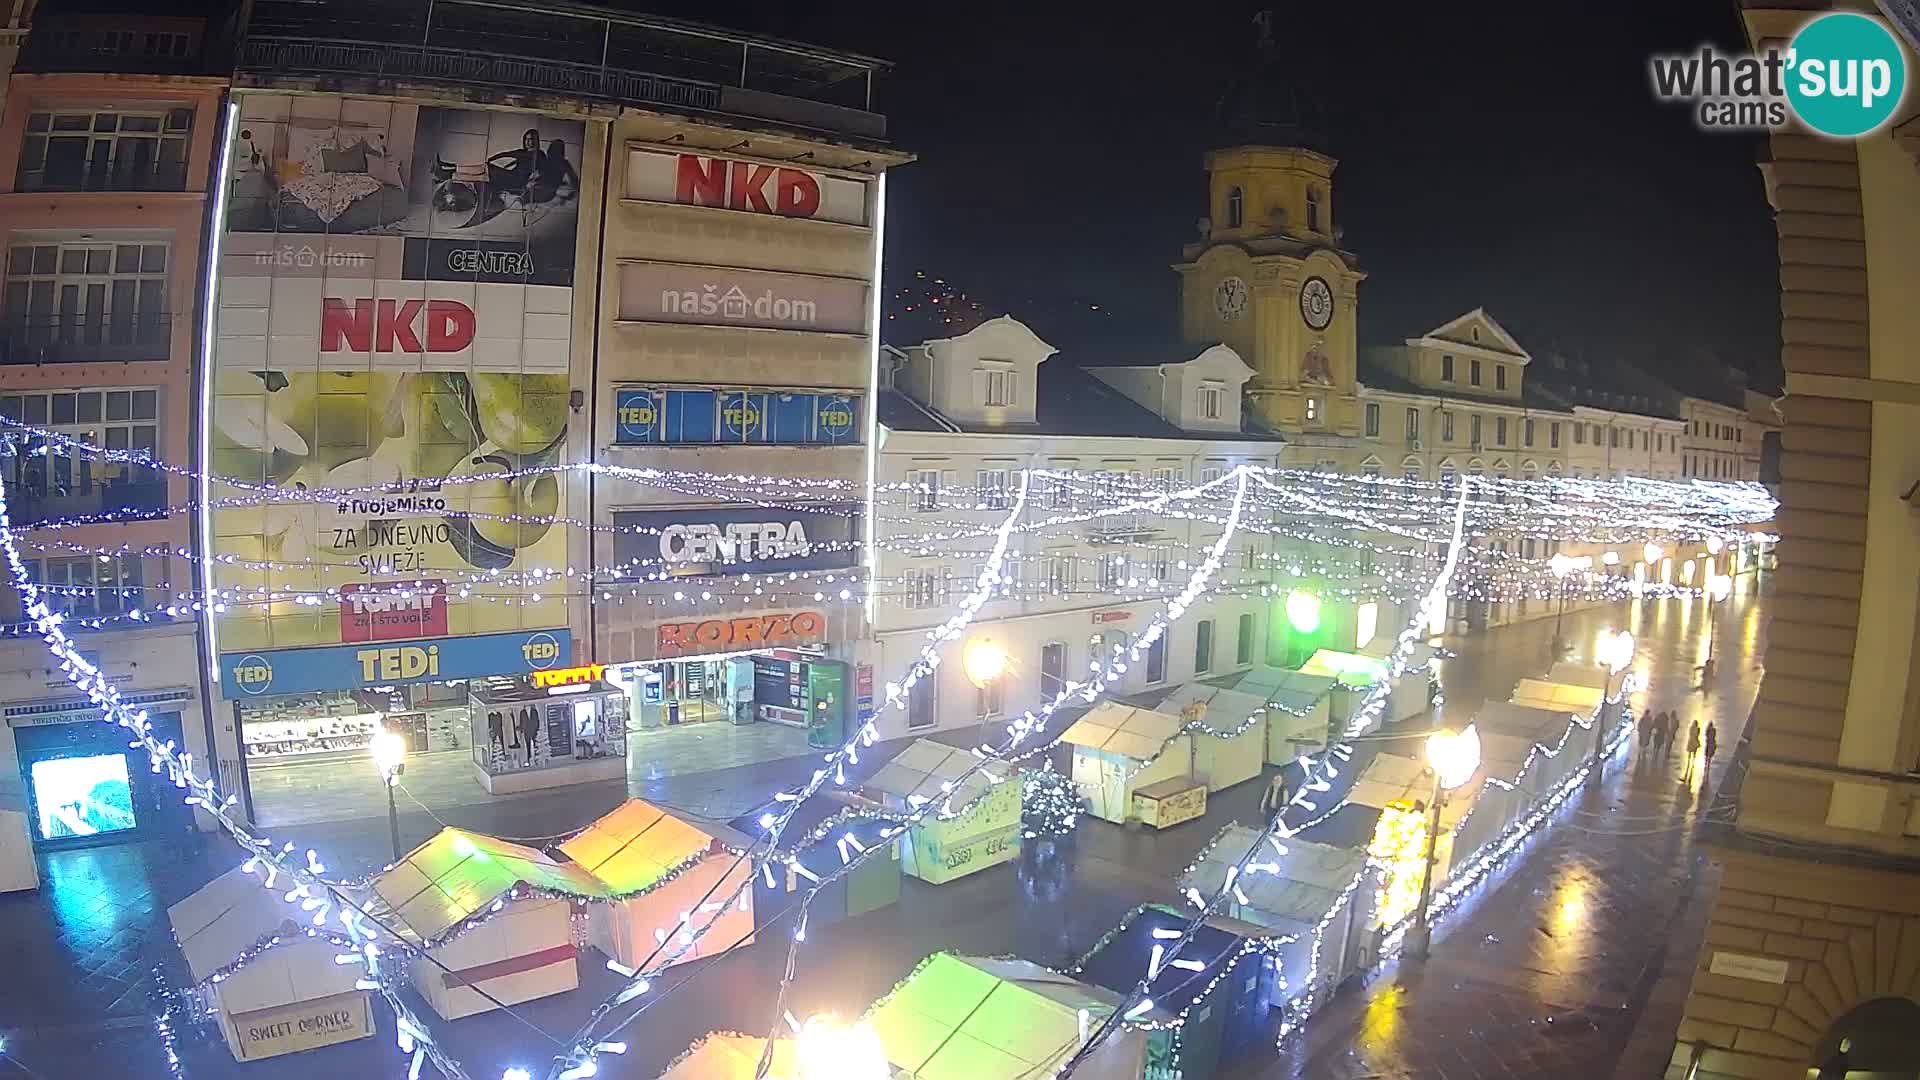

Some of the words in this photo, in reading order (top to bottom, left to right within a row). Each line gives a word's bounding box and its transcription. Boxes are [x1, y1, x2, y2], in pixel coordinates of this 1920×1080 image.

[675, 154, 821, 218] NKD
[256, 246, 293, 266] naš
[320, 246, 366, 267] dom
[448, 249, 535, 274] CENTRA
[661, 284, 717, 315] naš
[755, 290, 816, 323] dom
[320, 298, 477, 353] NKD
[618, 408, 657, 425] TEDi
[723, 408, 759, 425] TEDi
[820, 409, 854, 426] TEDi
[333, 528, 357, 549] ZA
[368, 524, 450, 548] DNEVNO
[660, 520, 810, 562] CENTRA
[659, 612, 824, 649] KORZO
[358, 645, 440, 682] TEDi
[522, 642, 560, 661] TEDi
[233, 665, 273, 684] TEDi
[532, 664, 604, 689] TOMMY
[249, 1021, 292, 1042] SWEET
[298, 1010, 350, 1033] CORNER
